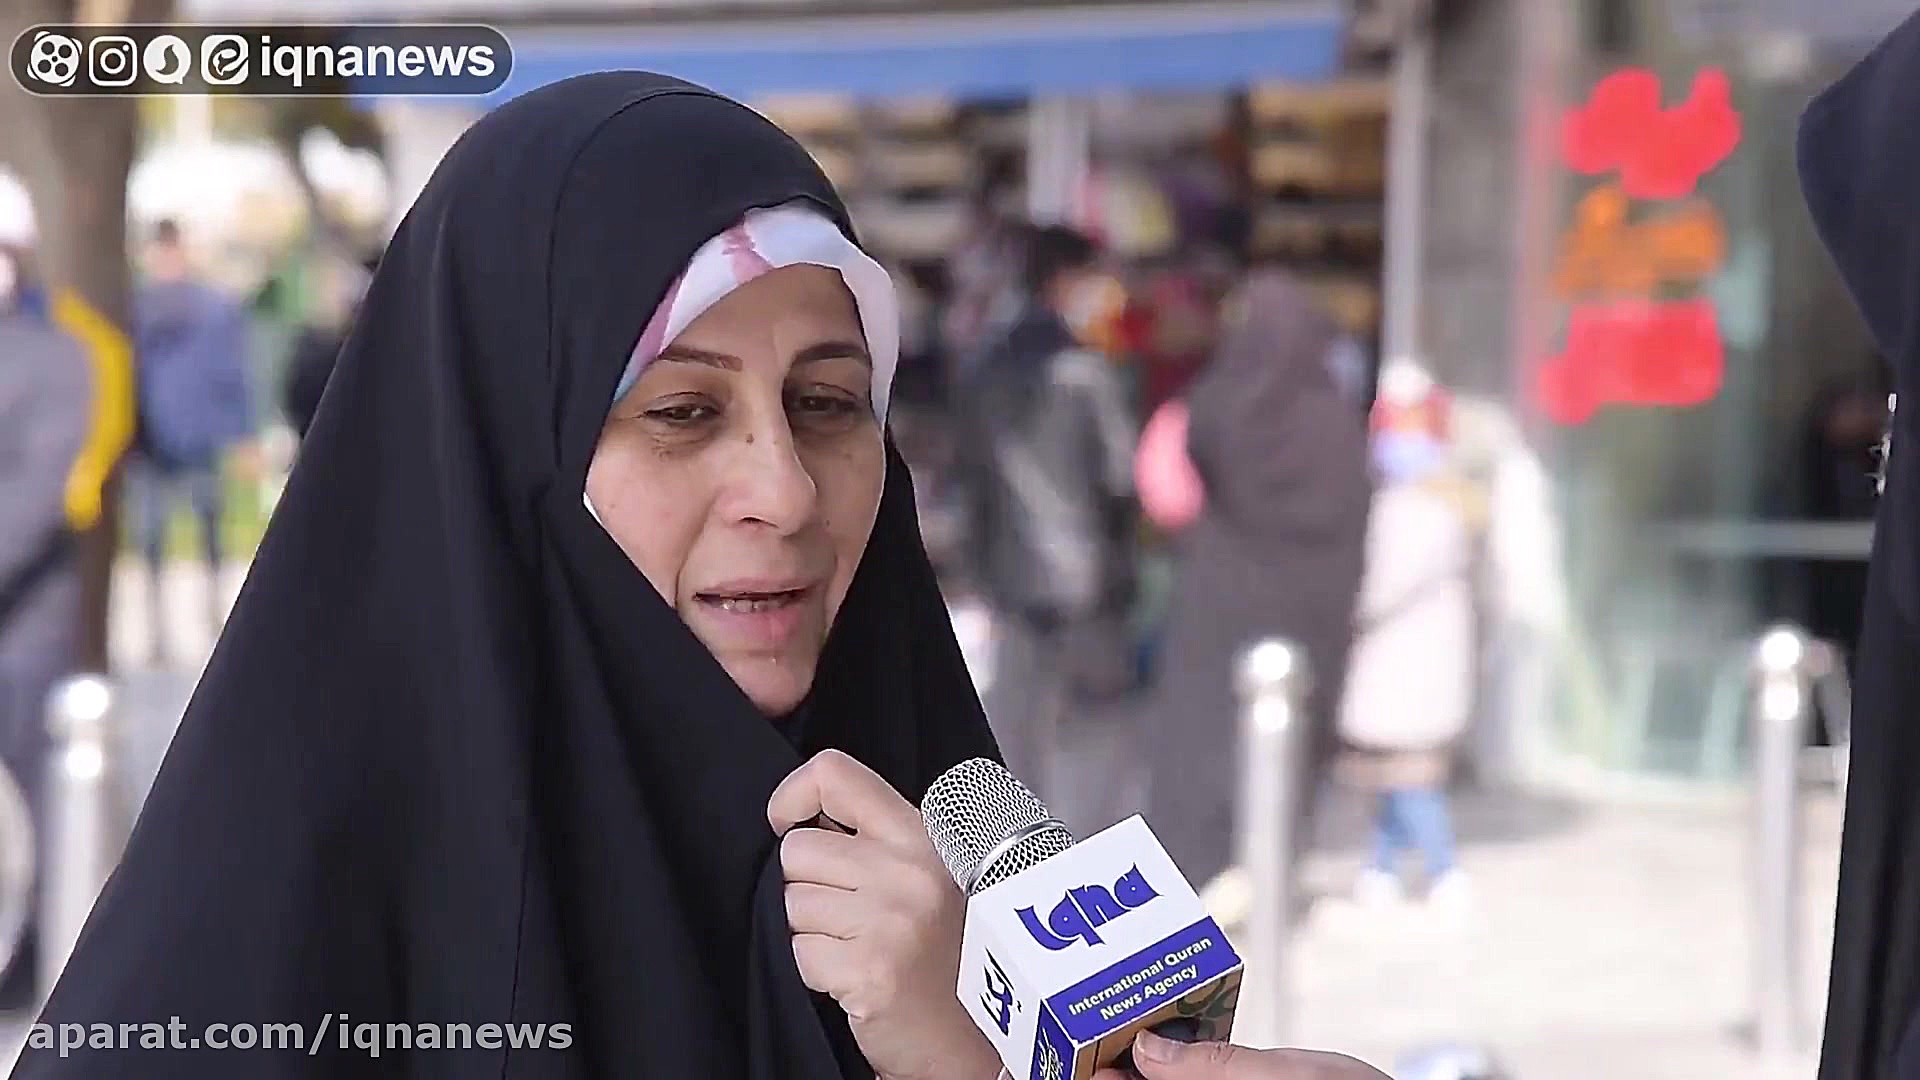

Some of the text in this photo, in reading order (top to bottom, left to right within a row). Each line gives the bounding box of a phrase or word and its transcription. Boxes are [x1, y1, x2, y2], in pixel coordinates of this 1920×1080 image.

[1068, 938, 1213, 1015] International Quran
[1100, 964, 1198, 1020] News Agency
